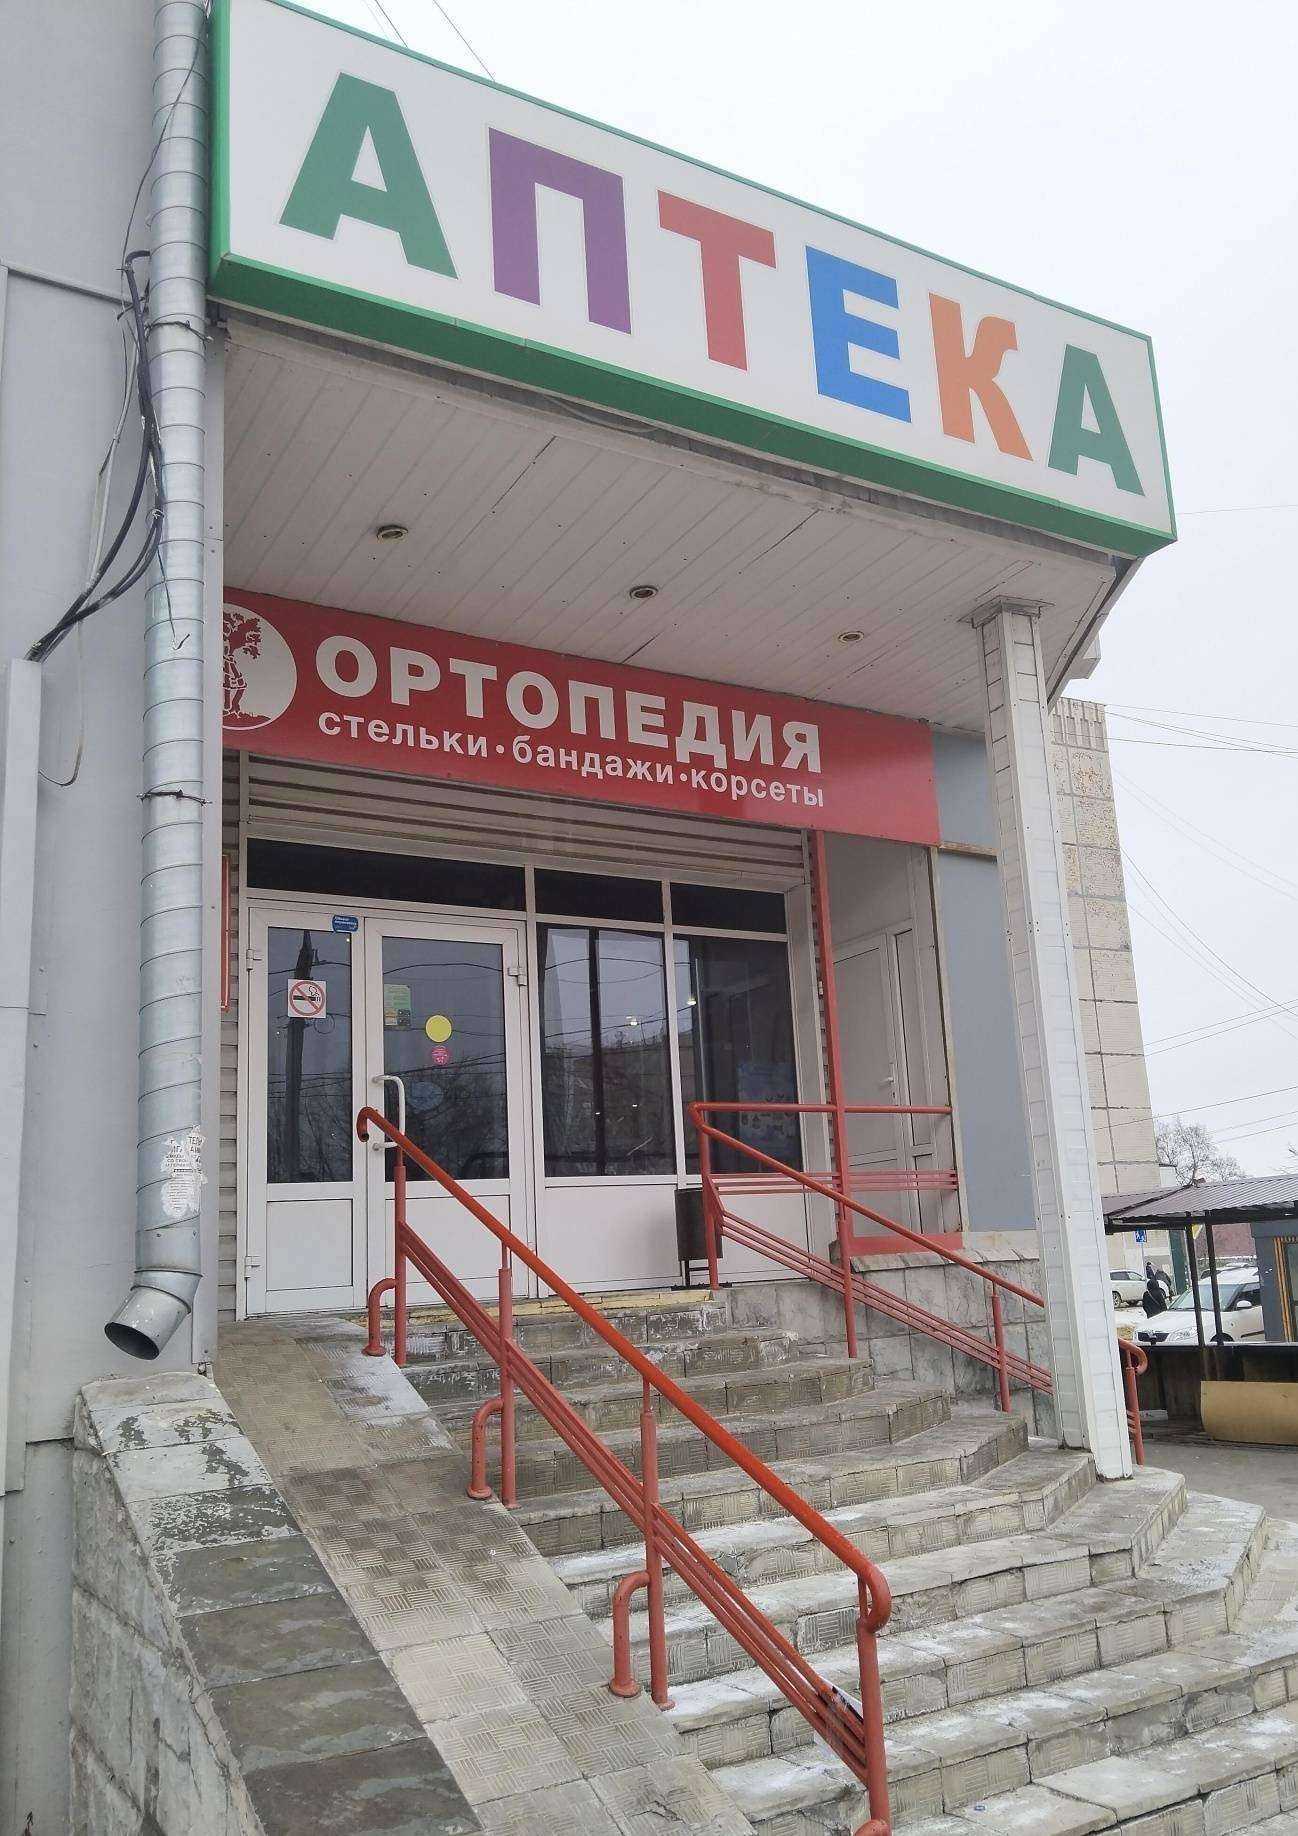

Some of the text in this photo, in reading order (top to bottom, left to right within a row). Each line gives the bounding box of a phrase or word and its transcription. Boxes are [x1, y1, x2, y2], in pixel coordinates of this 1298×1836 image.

[279, 72, 1145, 497] АПТЕКА
[316, 635, 822, 774] ОРТОПЕДИЯ
[318, 711, 826, 808] стельки бандажи корсеты
